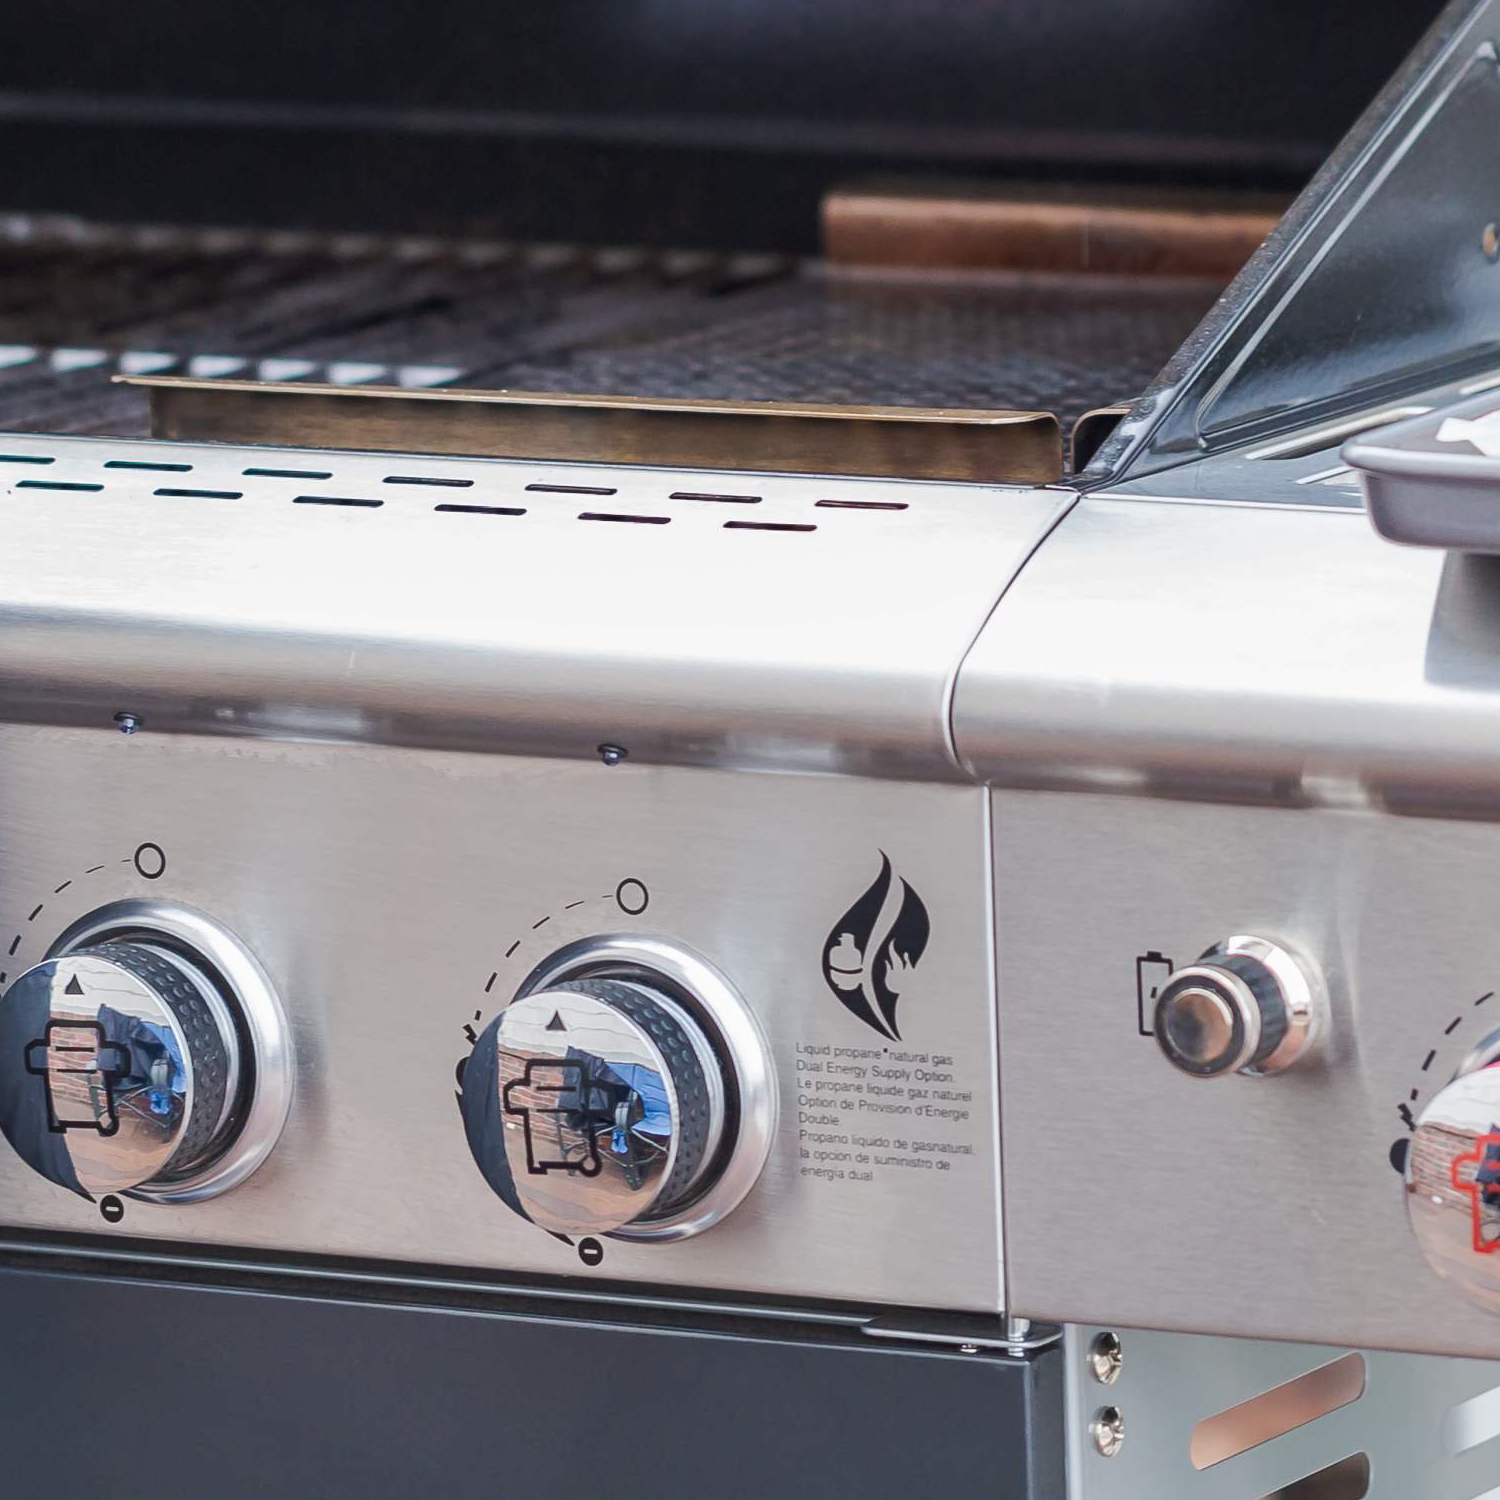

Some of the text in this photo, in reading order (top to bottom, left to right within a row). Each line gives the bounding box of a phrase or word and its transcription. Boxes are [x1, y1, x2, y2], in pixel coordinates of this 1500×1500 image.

[796, 1042, 953, 1067] Liquid propane natural gas
[797, 1060, 822, 1072] Dual
[827, 1062, 867, 1078] Energy
[872, 1066, 911, 1081] Supply
[798, 1078, 972, 1101] Le propane liquide gaz naturel
[798, 1095, 836, 1108] Option
[840, 1100, 854, 1110] de
[859, 1100, 911, 1114] Provision
[800, 1130, 848, 1144] Propano
[894, 1139, 908, 1149] de
[800, 1148, 809, 1159] la
[856, 1153, 869, 1163] de
[874, 1155, 932, 1169] suministro
[936, 1160, 950, 1170] de
